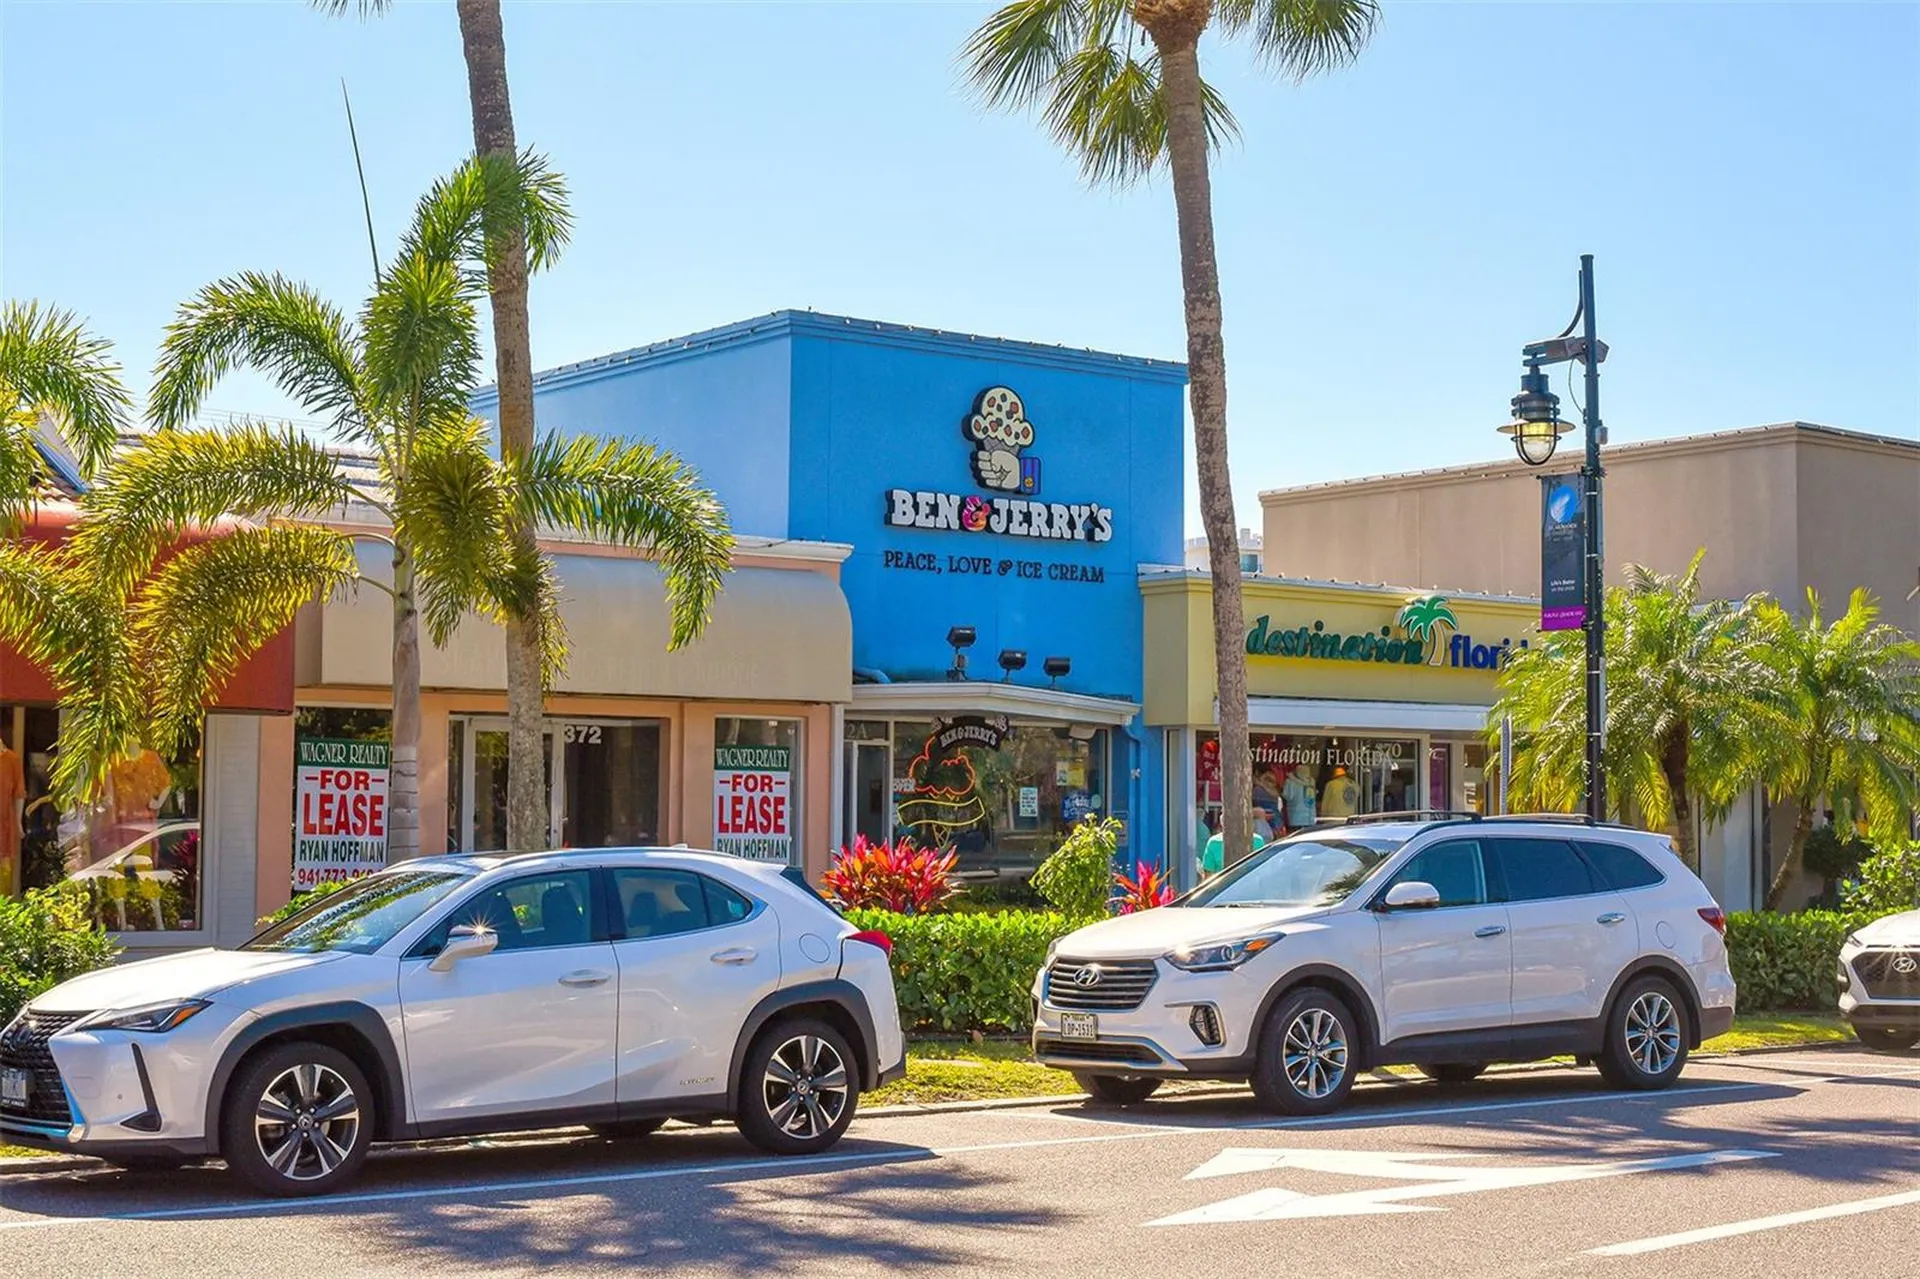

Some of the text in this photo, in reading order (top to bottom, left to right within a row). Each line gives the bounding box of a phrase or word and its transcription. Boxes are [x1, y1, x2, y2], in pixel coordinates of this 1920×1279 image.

[886, 488, 960, 531] BEN
[990, 499, 1113, 542] JERRY'S
[884, 550, 942, 574] PEACE,
[948, 554, 992, 575] LOVE
[1017, 560, 1043, 579] ICE
[1049, 564, 1104, 583] CREAM
[1246, 615, 1424, 665] destination
[564, 725, 602, 744] 372
[964, 725, 998, 746] JERRY'S
[300, 741, 387, 763] WAGNER REALTY
[715, 748, 789, 768] WAGNER REALTY
[1248, 742, 1394, 766] stination FLORIDA
[303, 793, 384, 836] LEASE
[718, 795, 786, 835] LEASE
[299, 839, 384, 863] RYAN HOFFMAN
[717, 838, 788, 859] RYAN HOFFMAN
